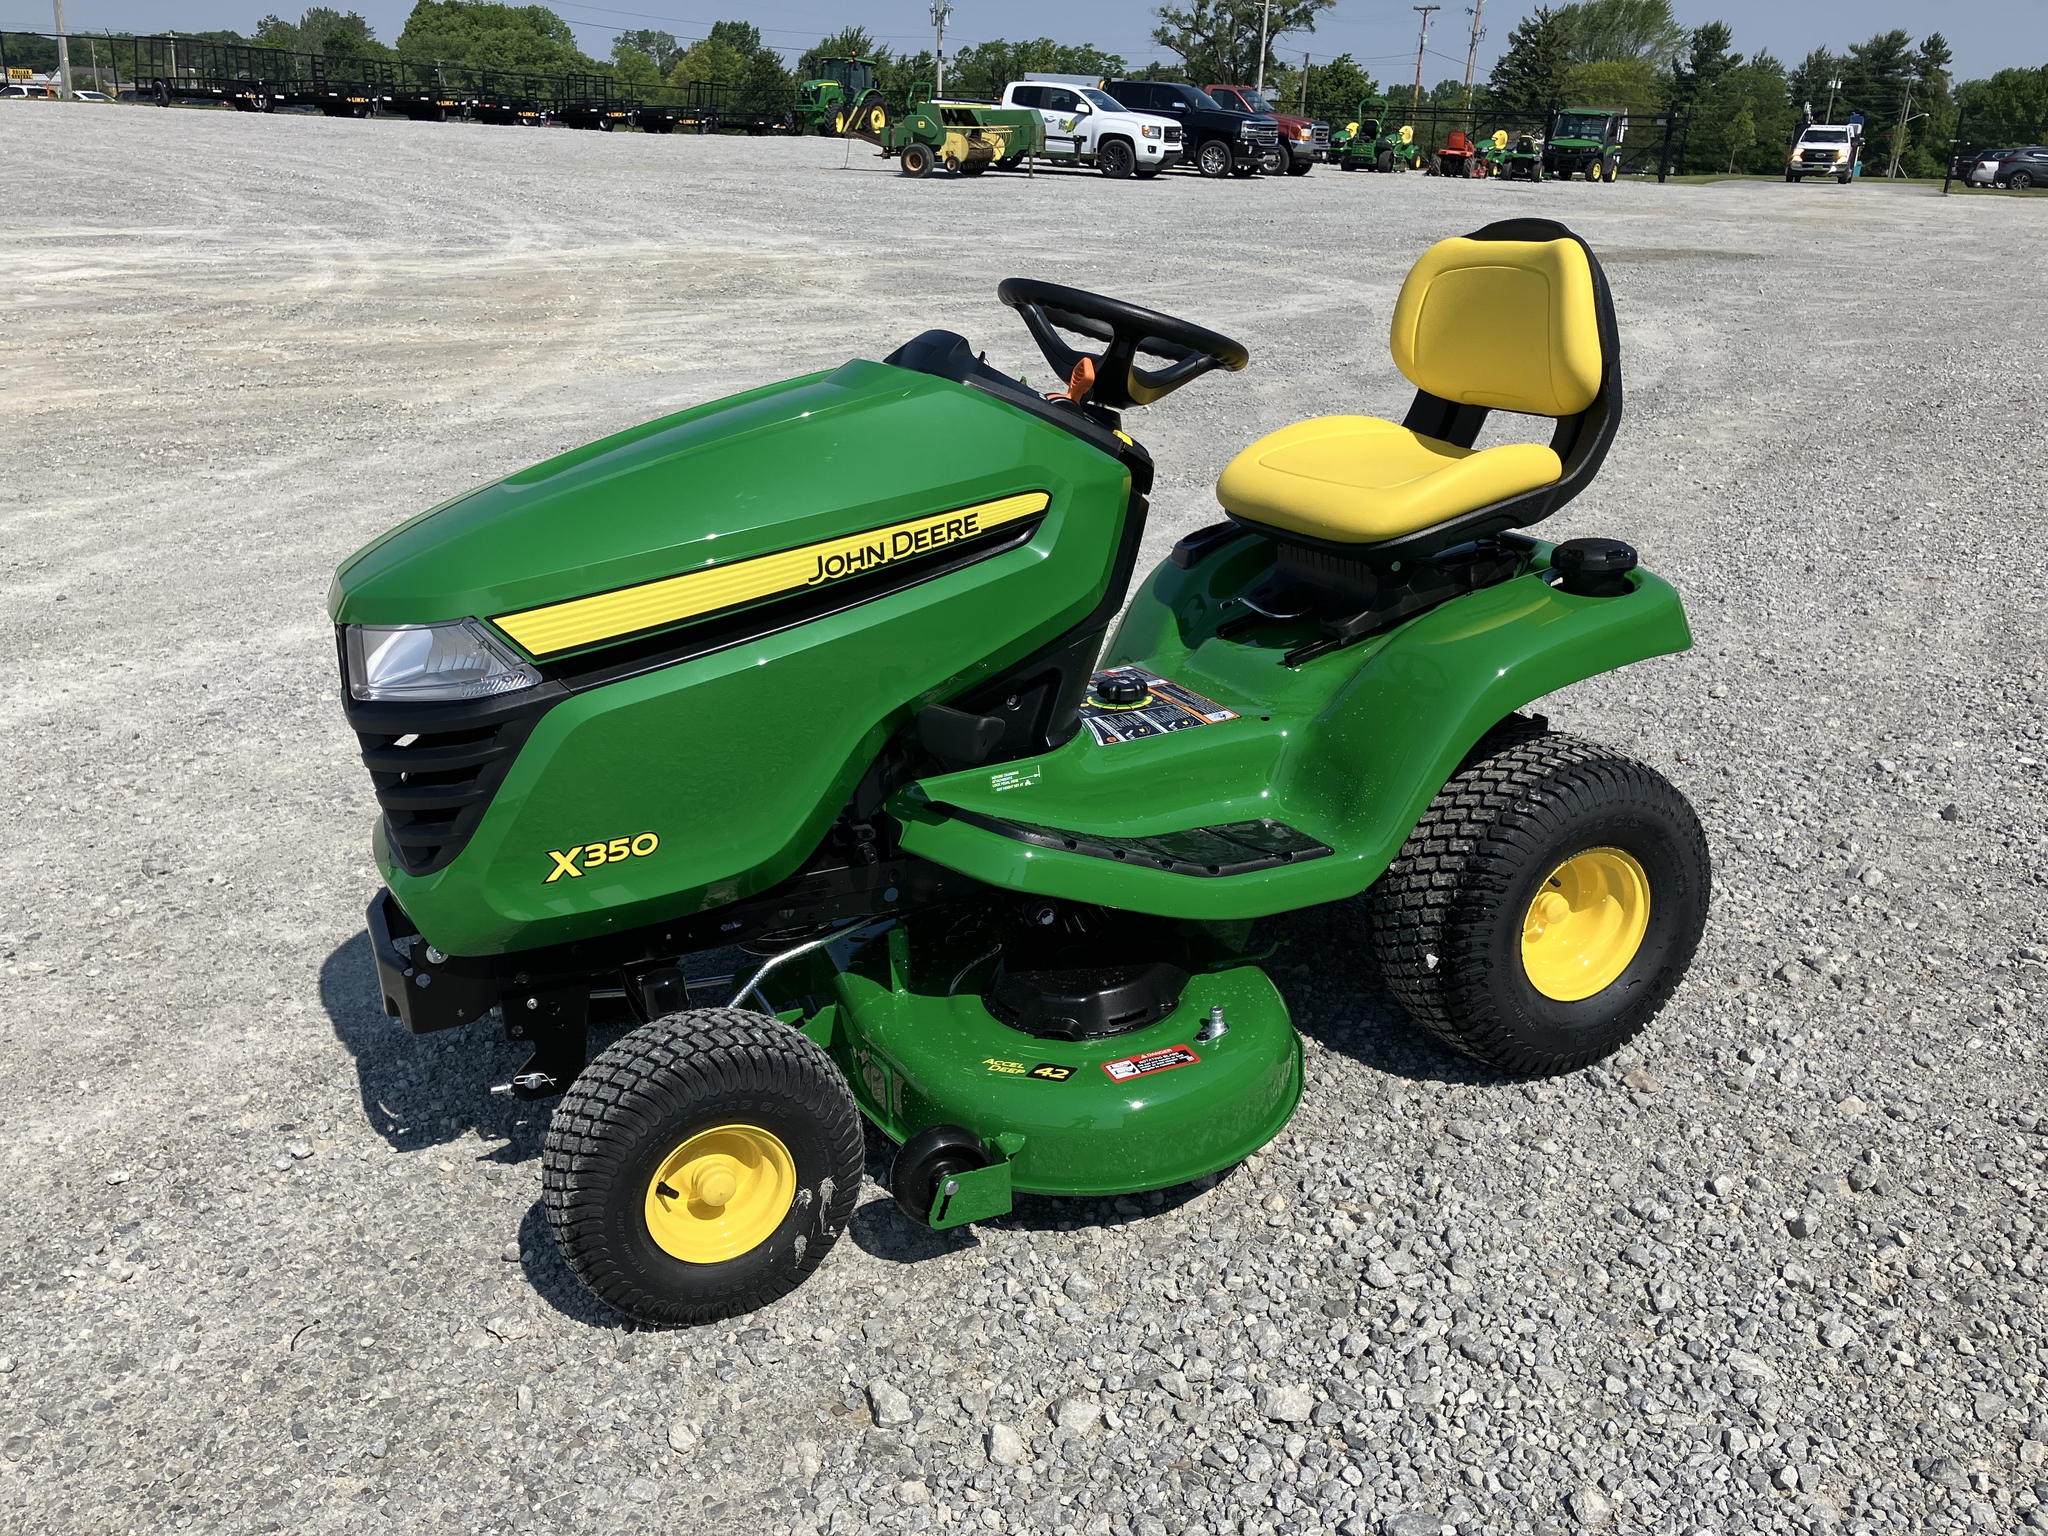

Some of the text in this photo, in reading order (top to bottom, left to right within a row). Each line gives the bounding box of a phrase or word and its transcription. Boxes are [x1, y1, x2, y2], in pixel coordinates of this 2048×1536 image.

[807, 512, 980, 583] JOHN DEERE
[542, 831, 660, 884] X350
[1146, 1048, 1173, 1057] DANGER
[981, 1058, 1025, 1069] ACCEL
[987, 1064, 1026, 1074] DEEP
[1034, 1067, 1070, 1079] 42
